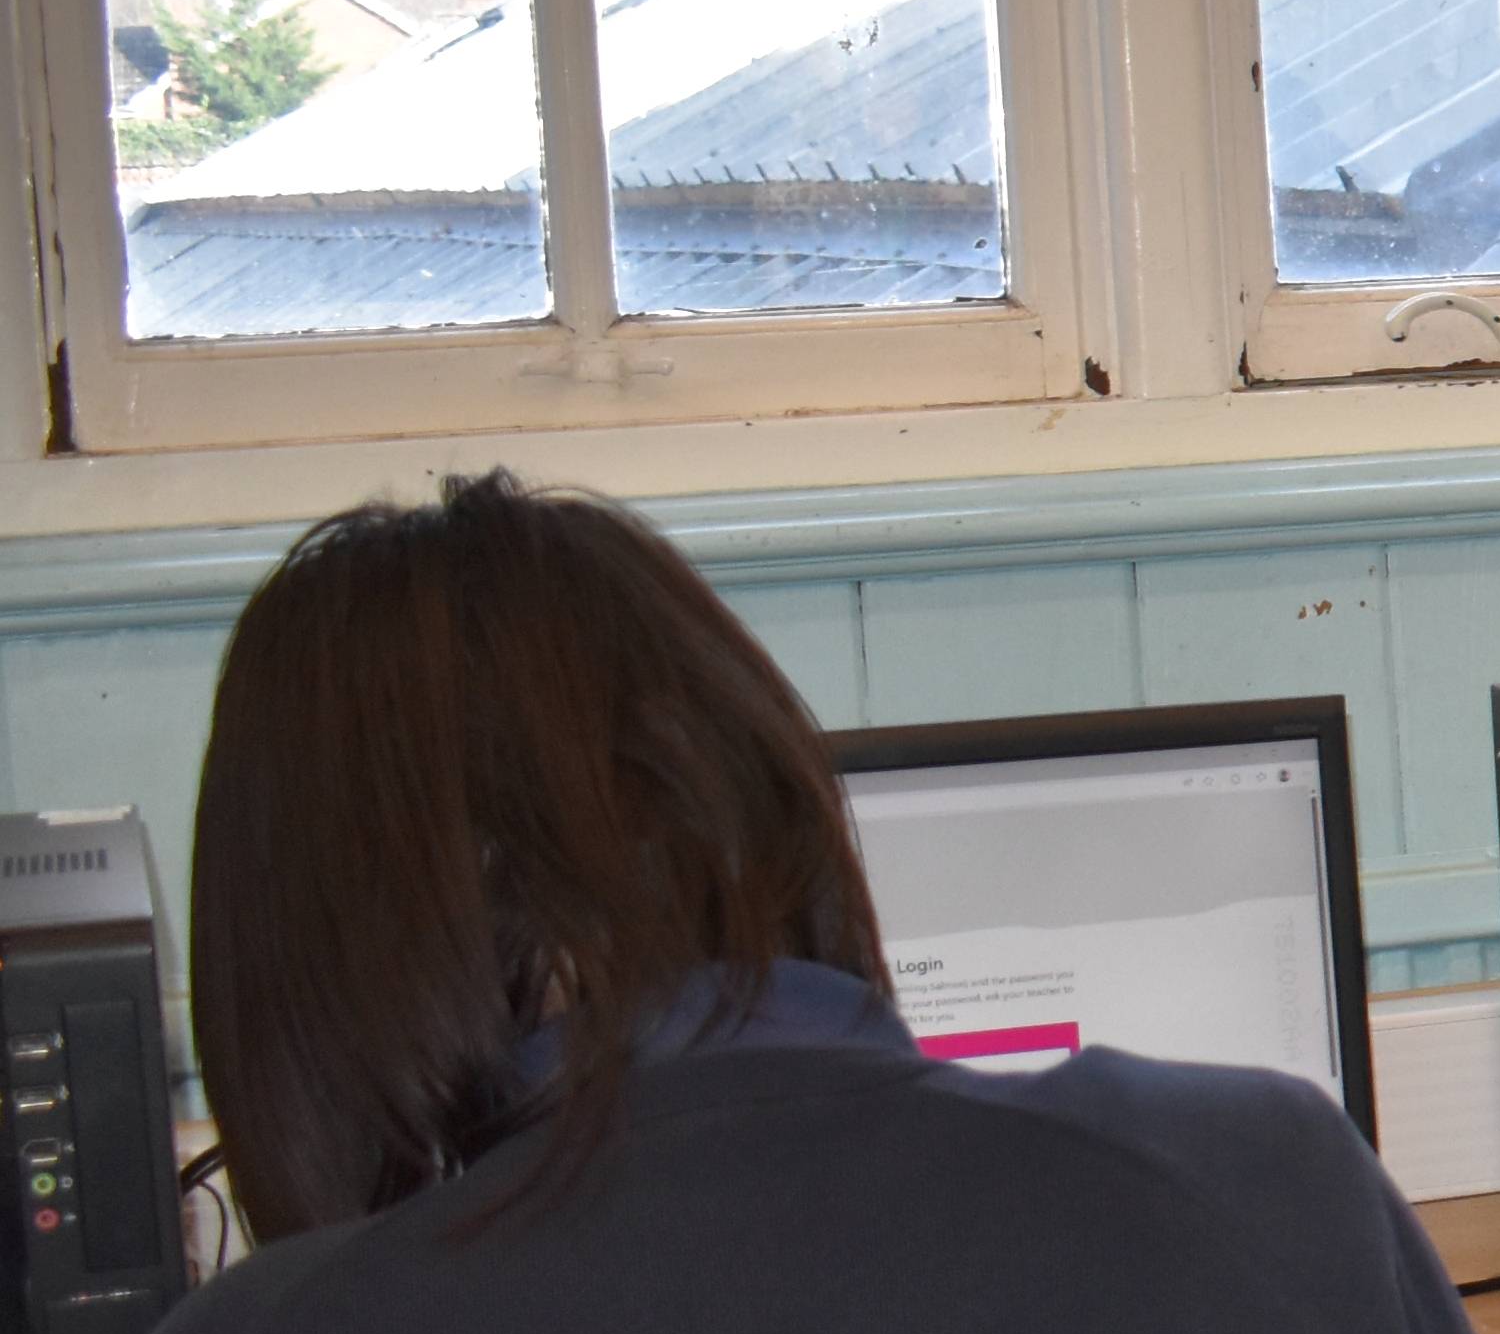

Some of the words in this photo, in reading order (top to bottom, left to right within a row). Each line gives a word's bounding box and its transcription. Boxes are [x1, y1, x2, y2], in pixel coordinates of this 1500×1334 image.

[896, 956, 944, 976] Login
[971, 976, 989, 987] and
[991, 974, 1006, 985] the
[1008, 971, 1053, 985] password
[1056, 970, 1075, 981] you
[1026, 986, 1061, 998] teacher
[1063, 984, 1075, 995] to
